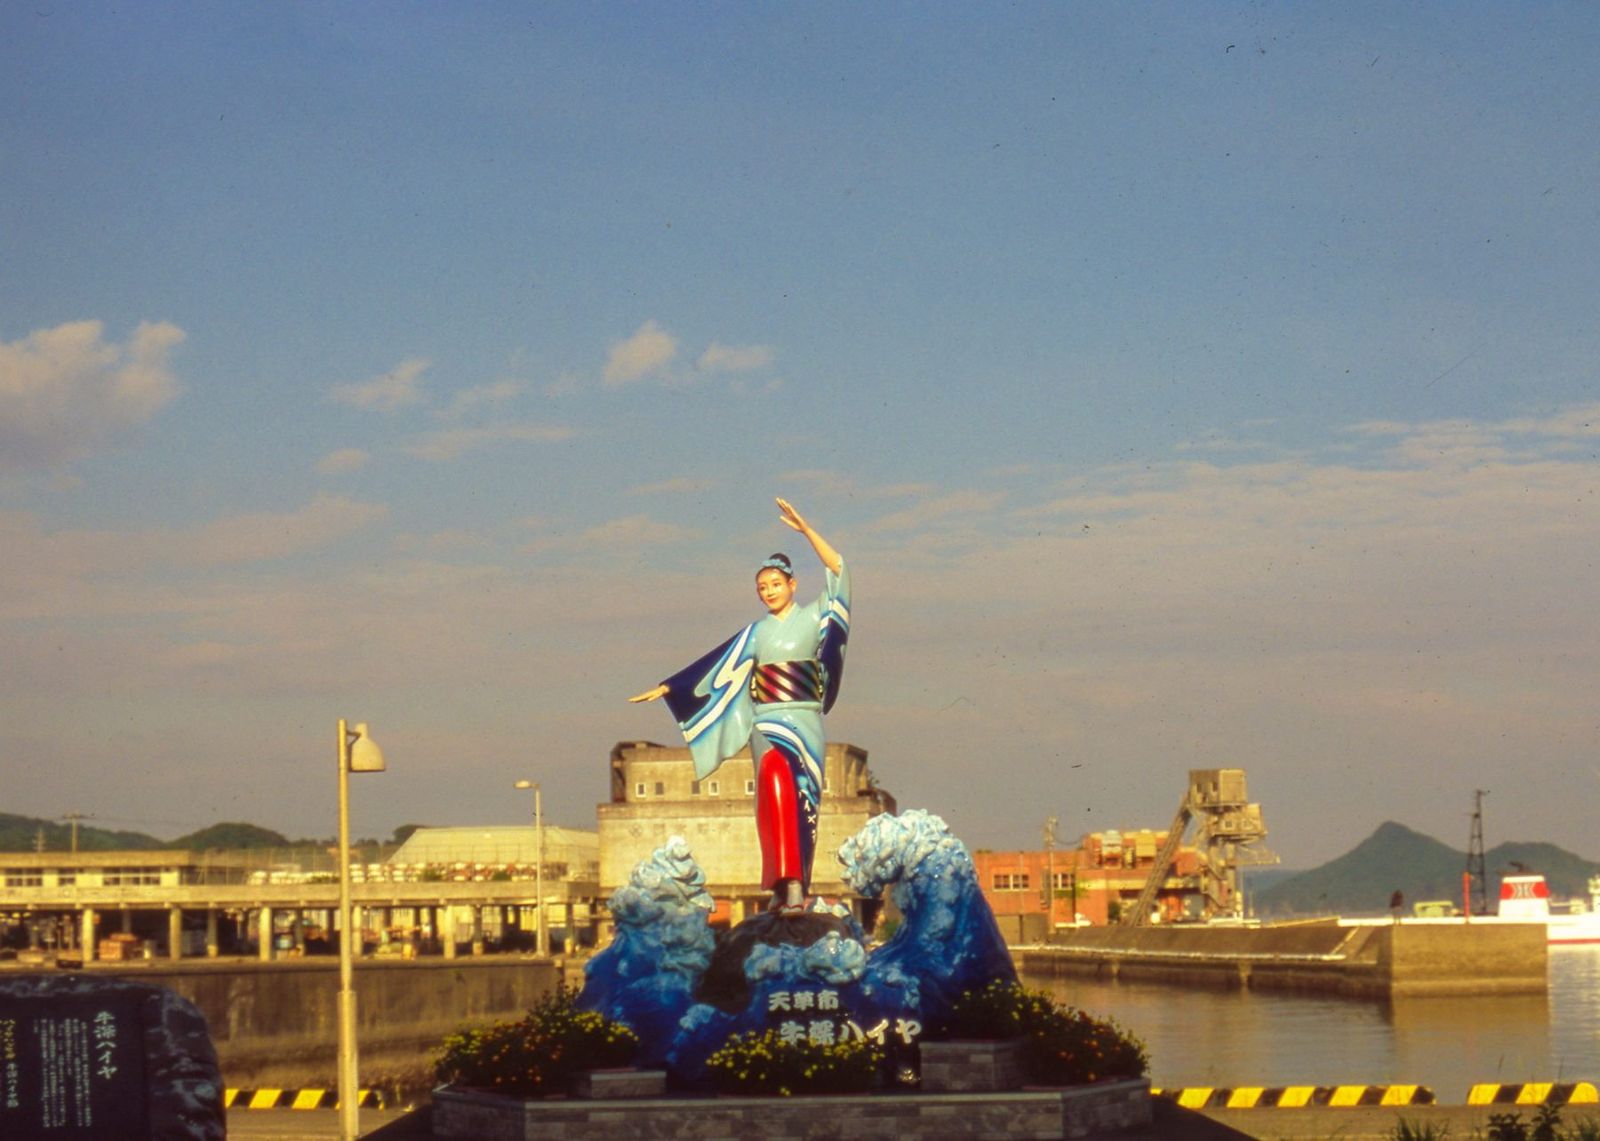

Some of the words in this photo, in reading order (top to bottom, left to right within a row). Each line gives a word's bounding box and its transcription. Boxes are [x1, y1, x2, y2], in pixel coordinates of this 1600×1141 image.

[768, 989, 839, 1011] 天草市
[93, 1011, 117, 1079] 牛深ハイヤ
